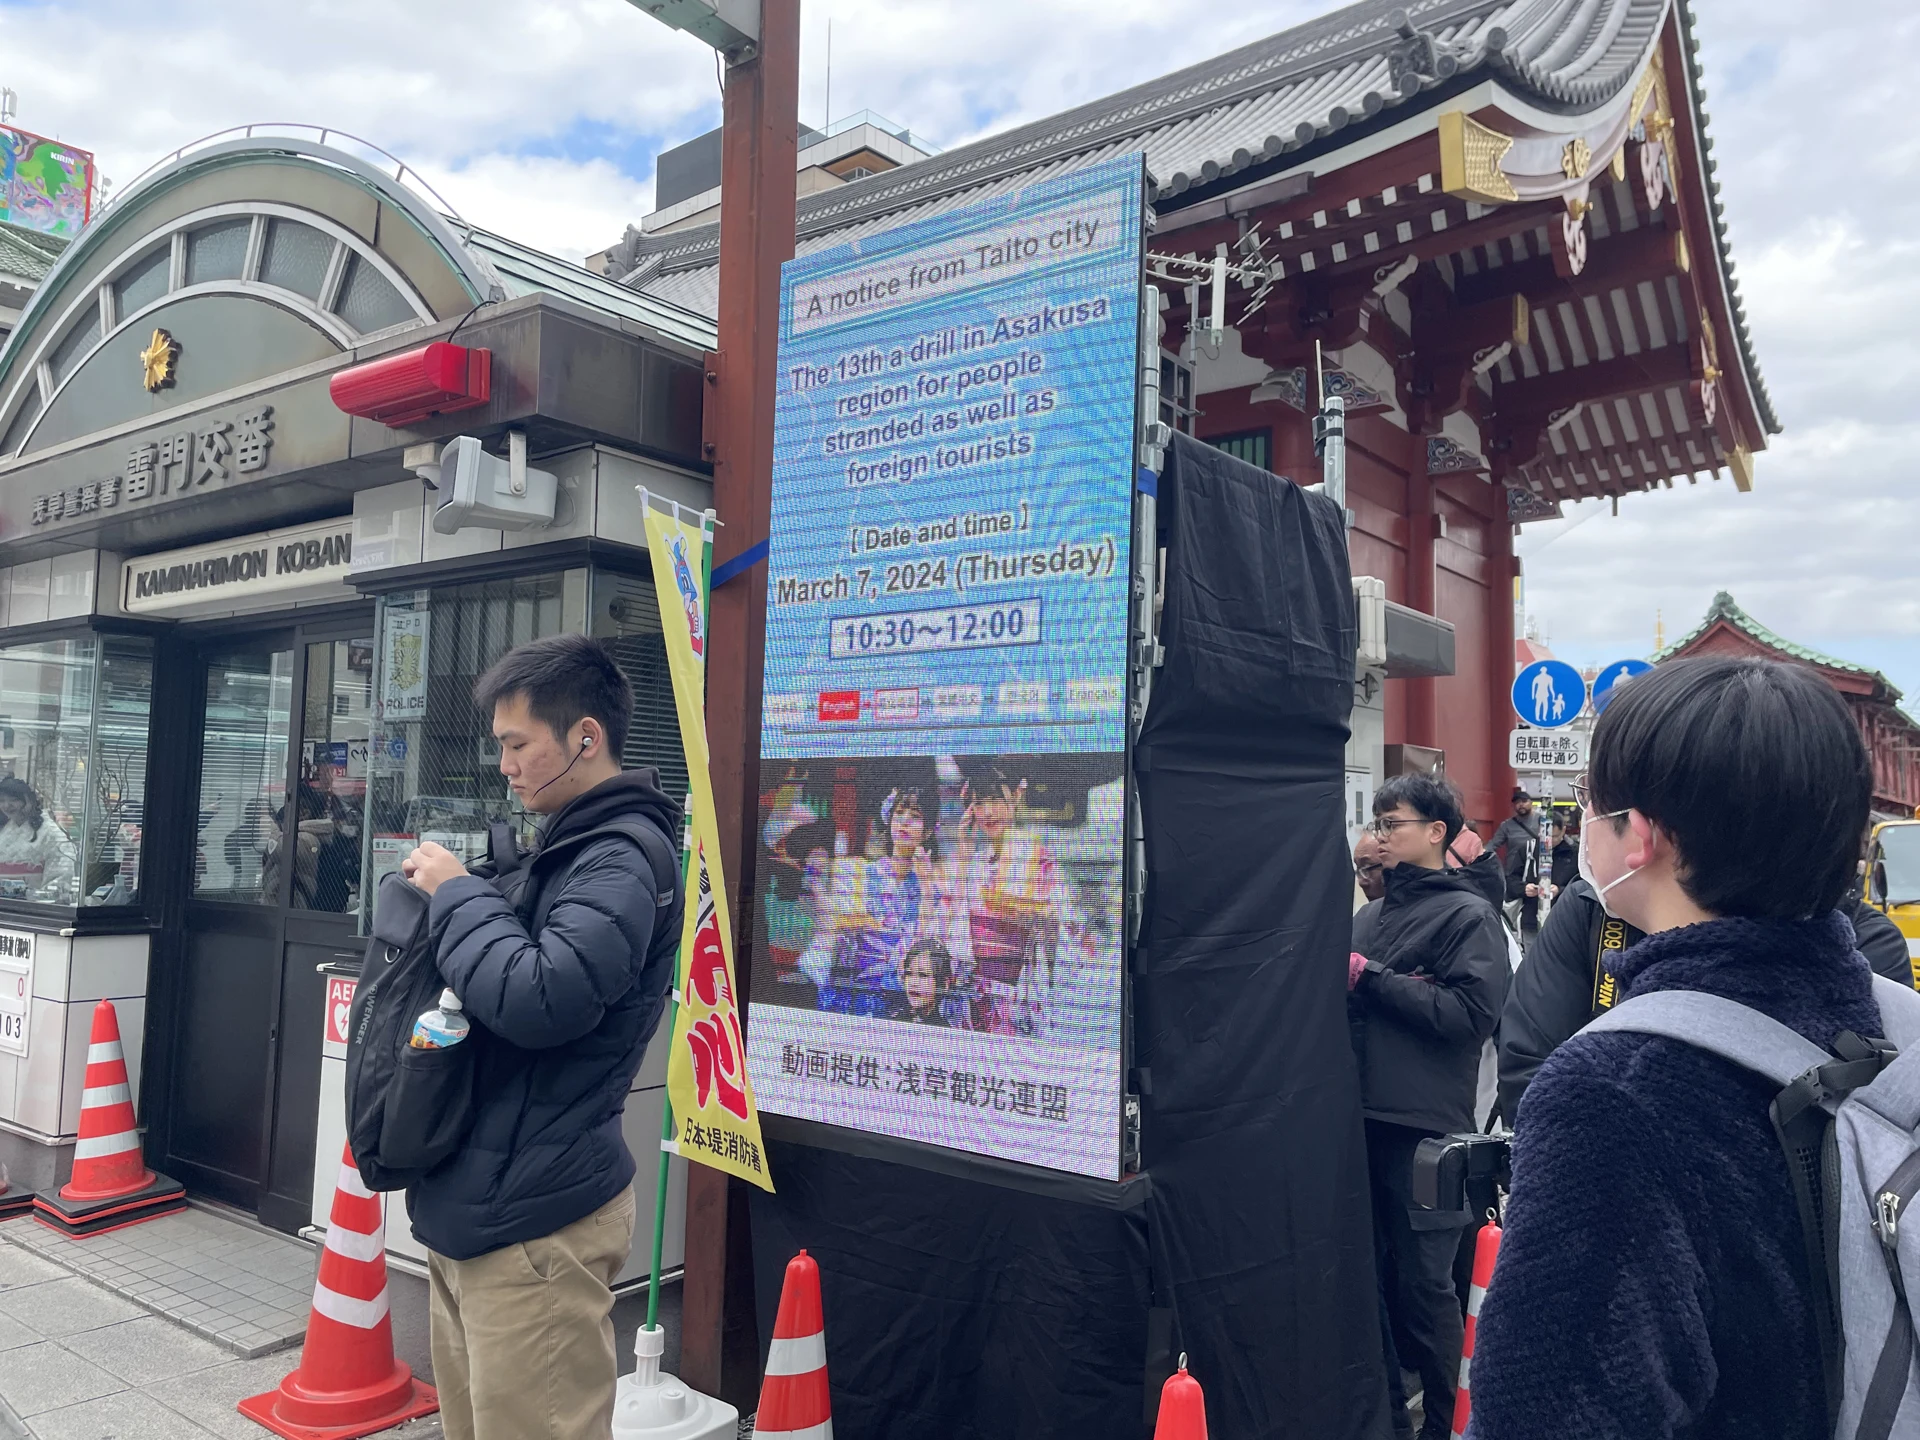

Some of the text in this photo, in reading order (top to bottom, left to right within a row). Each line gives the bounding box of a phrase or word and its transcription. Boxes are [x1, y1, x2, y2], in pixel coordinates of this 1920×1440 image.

[50, 152, 75, 165] KIRIN
[806, 218, 1100, 318] A notice from Taito city
[791, 297, 1107, 392] The 13th a drill in Asakusa
[837, 352, 1042, 418] region for people
[825, 390, 1054, 454] stranded as well as
[127, 404, 275, 500] 雷門交番
[848, 431, 1032, 486] foreign tourists
[866, 527, 911, 551] Date
[917, 522, 956, 544] and
[963, 514, 1012, 537] time
[136, 533, 352, 598] KAMINARIMON KOBAN
[777, 538, 1116, 604] March 7, 2024 (Thursday)
[386, 696, 424, 710] POLICE
[1515, 752, 1579, 765] 仲見世通り
[1516, 736, 1579, 749] 自転車を除く
[1602, 921, 1624, 952] 600
[17, 977, 25, 997] 0
[1599, 973, 1615, 1008] Nik
[355, 995, 377, 1044] WENGER
[683, 1116, 763, 1174] 日本堤消防署
